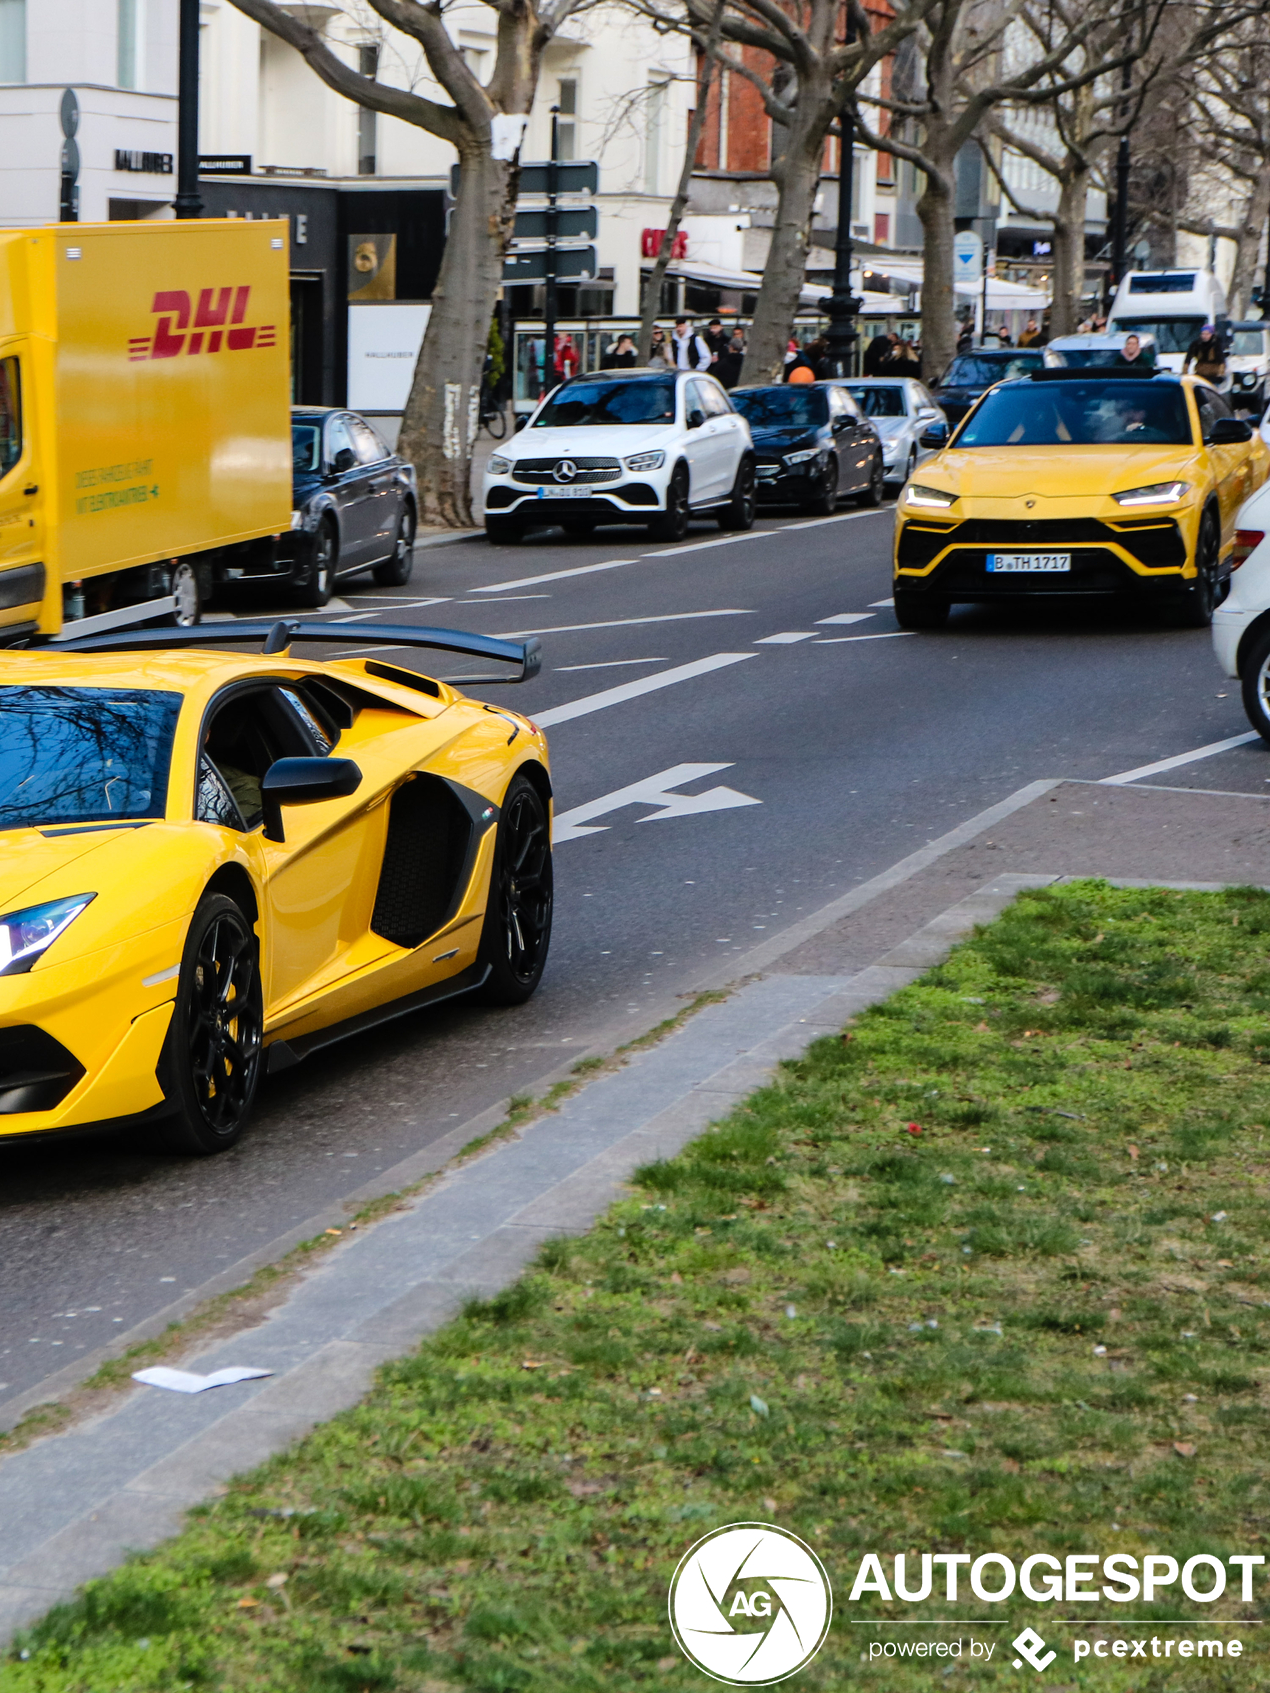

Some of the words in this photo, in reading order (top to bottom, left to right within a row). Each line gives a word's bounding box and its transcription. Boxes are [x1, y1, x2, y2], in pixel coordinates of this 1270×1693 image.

[150, 286, 257, 360] DHL
[995, 557, 1004, 570] B
[1013, 557, 1030, 570] TH
[1033, 557, 1069, 570] 1717
